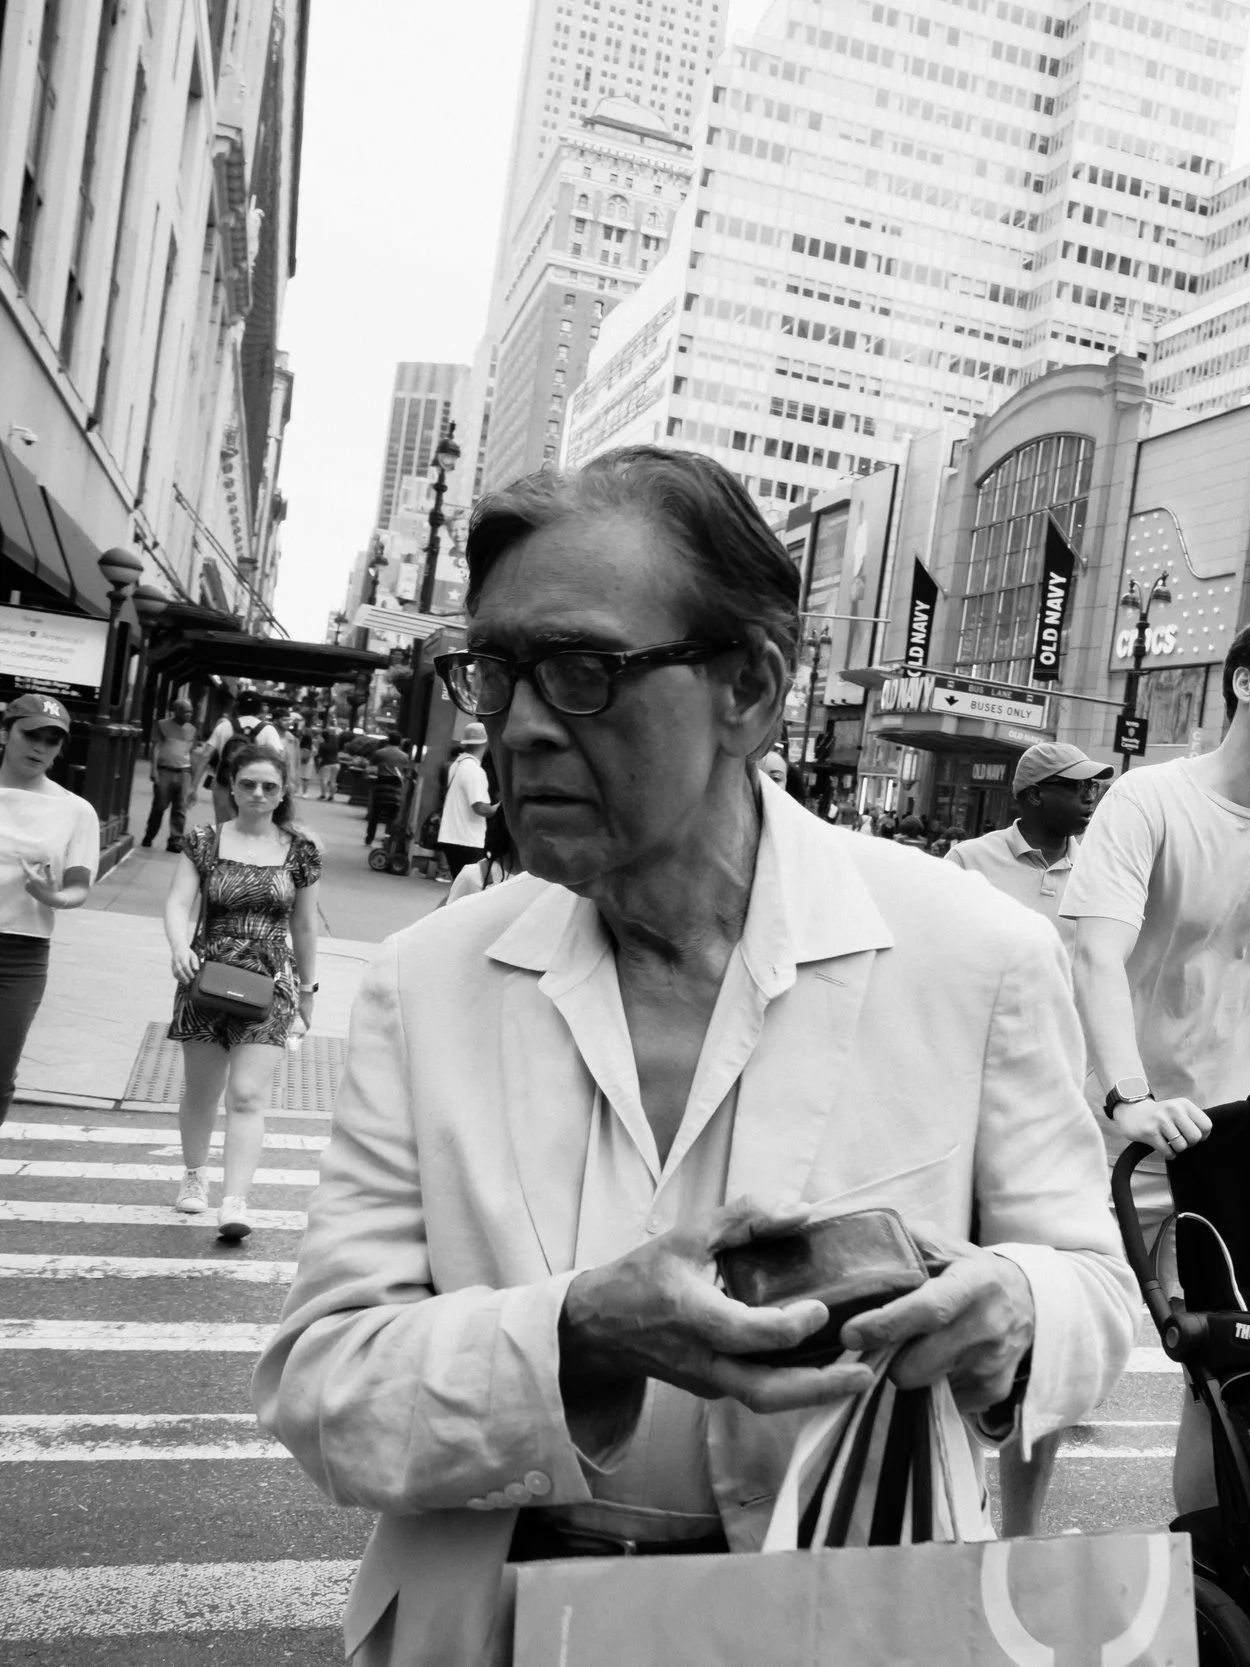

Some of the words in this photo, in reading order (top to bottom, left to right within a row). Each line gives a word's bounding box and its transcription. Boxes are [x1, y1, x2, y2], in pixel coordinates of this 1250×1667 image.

[1044, 571, 1068, 626] NAVY
[910, 600, 931, 645] NAVY
[1039, 627, 1059, 666] OLD
[968, 684, 984, 694] BUS
[991, 688, 1013, 700] LANE
[970, 700, 1003, 714] BUSES
[1006, 706, 1033, 720] ONLY
